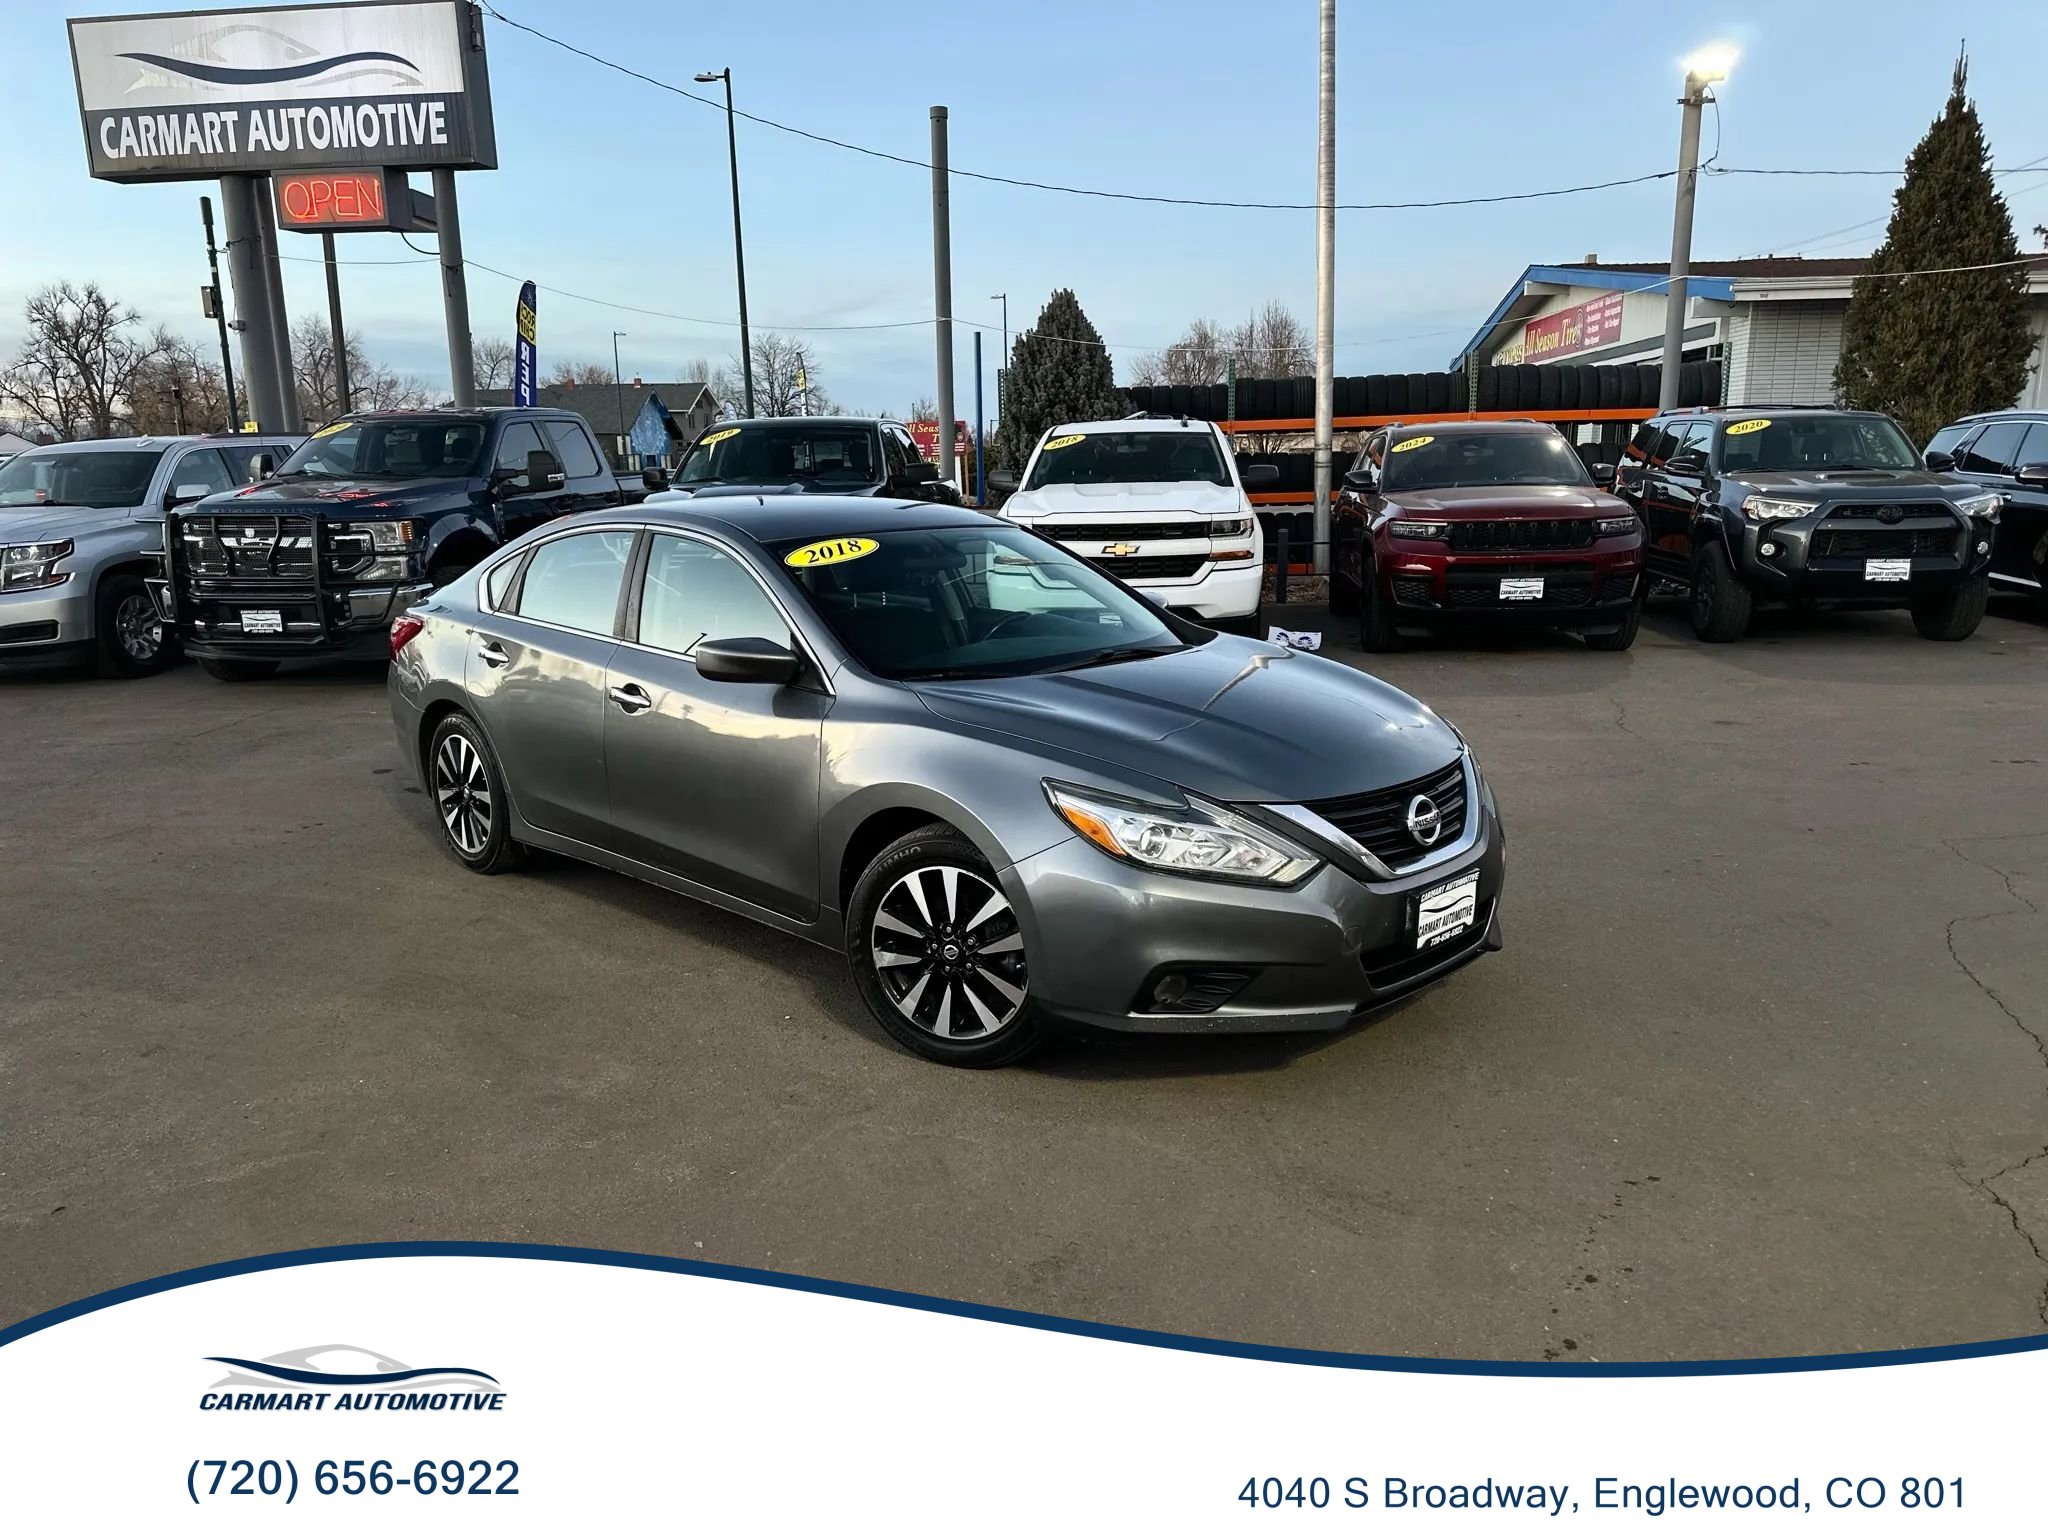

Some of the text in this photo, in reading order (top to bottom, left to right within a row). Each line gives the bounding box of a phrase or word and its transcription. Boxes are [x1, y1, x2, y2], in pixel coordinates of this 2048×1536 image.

[100, 101, 448, 159] CARMART AUTOMOTIVE
[284, 178, 383, 219] OPEN
[918, 424, 940, 433] Seas
[1735, 420, 1763, 433] 2020
[804, 540, 862, 563] 2018
[1420, 872, 1480, 902] CARMART AUTOMOTIVE
[1419, 904, 1474, 937] CARMART AUTOMOTIVE
